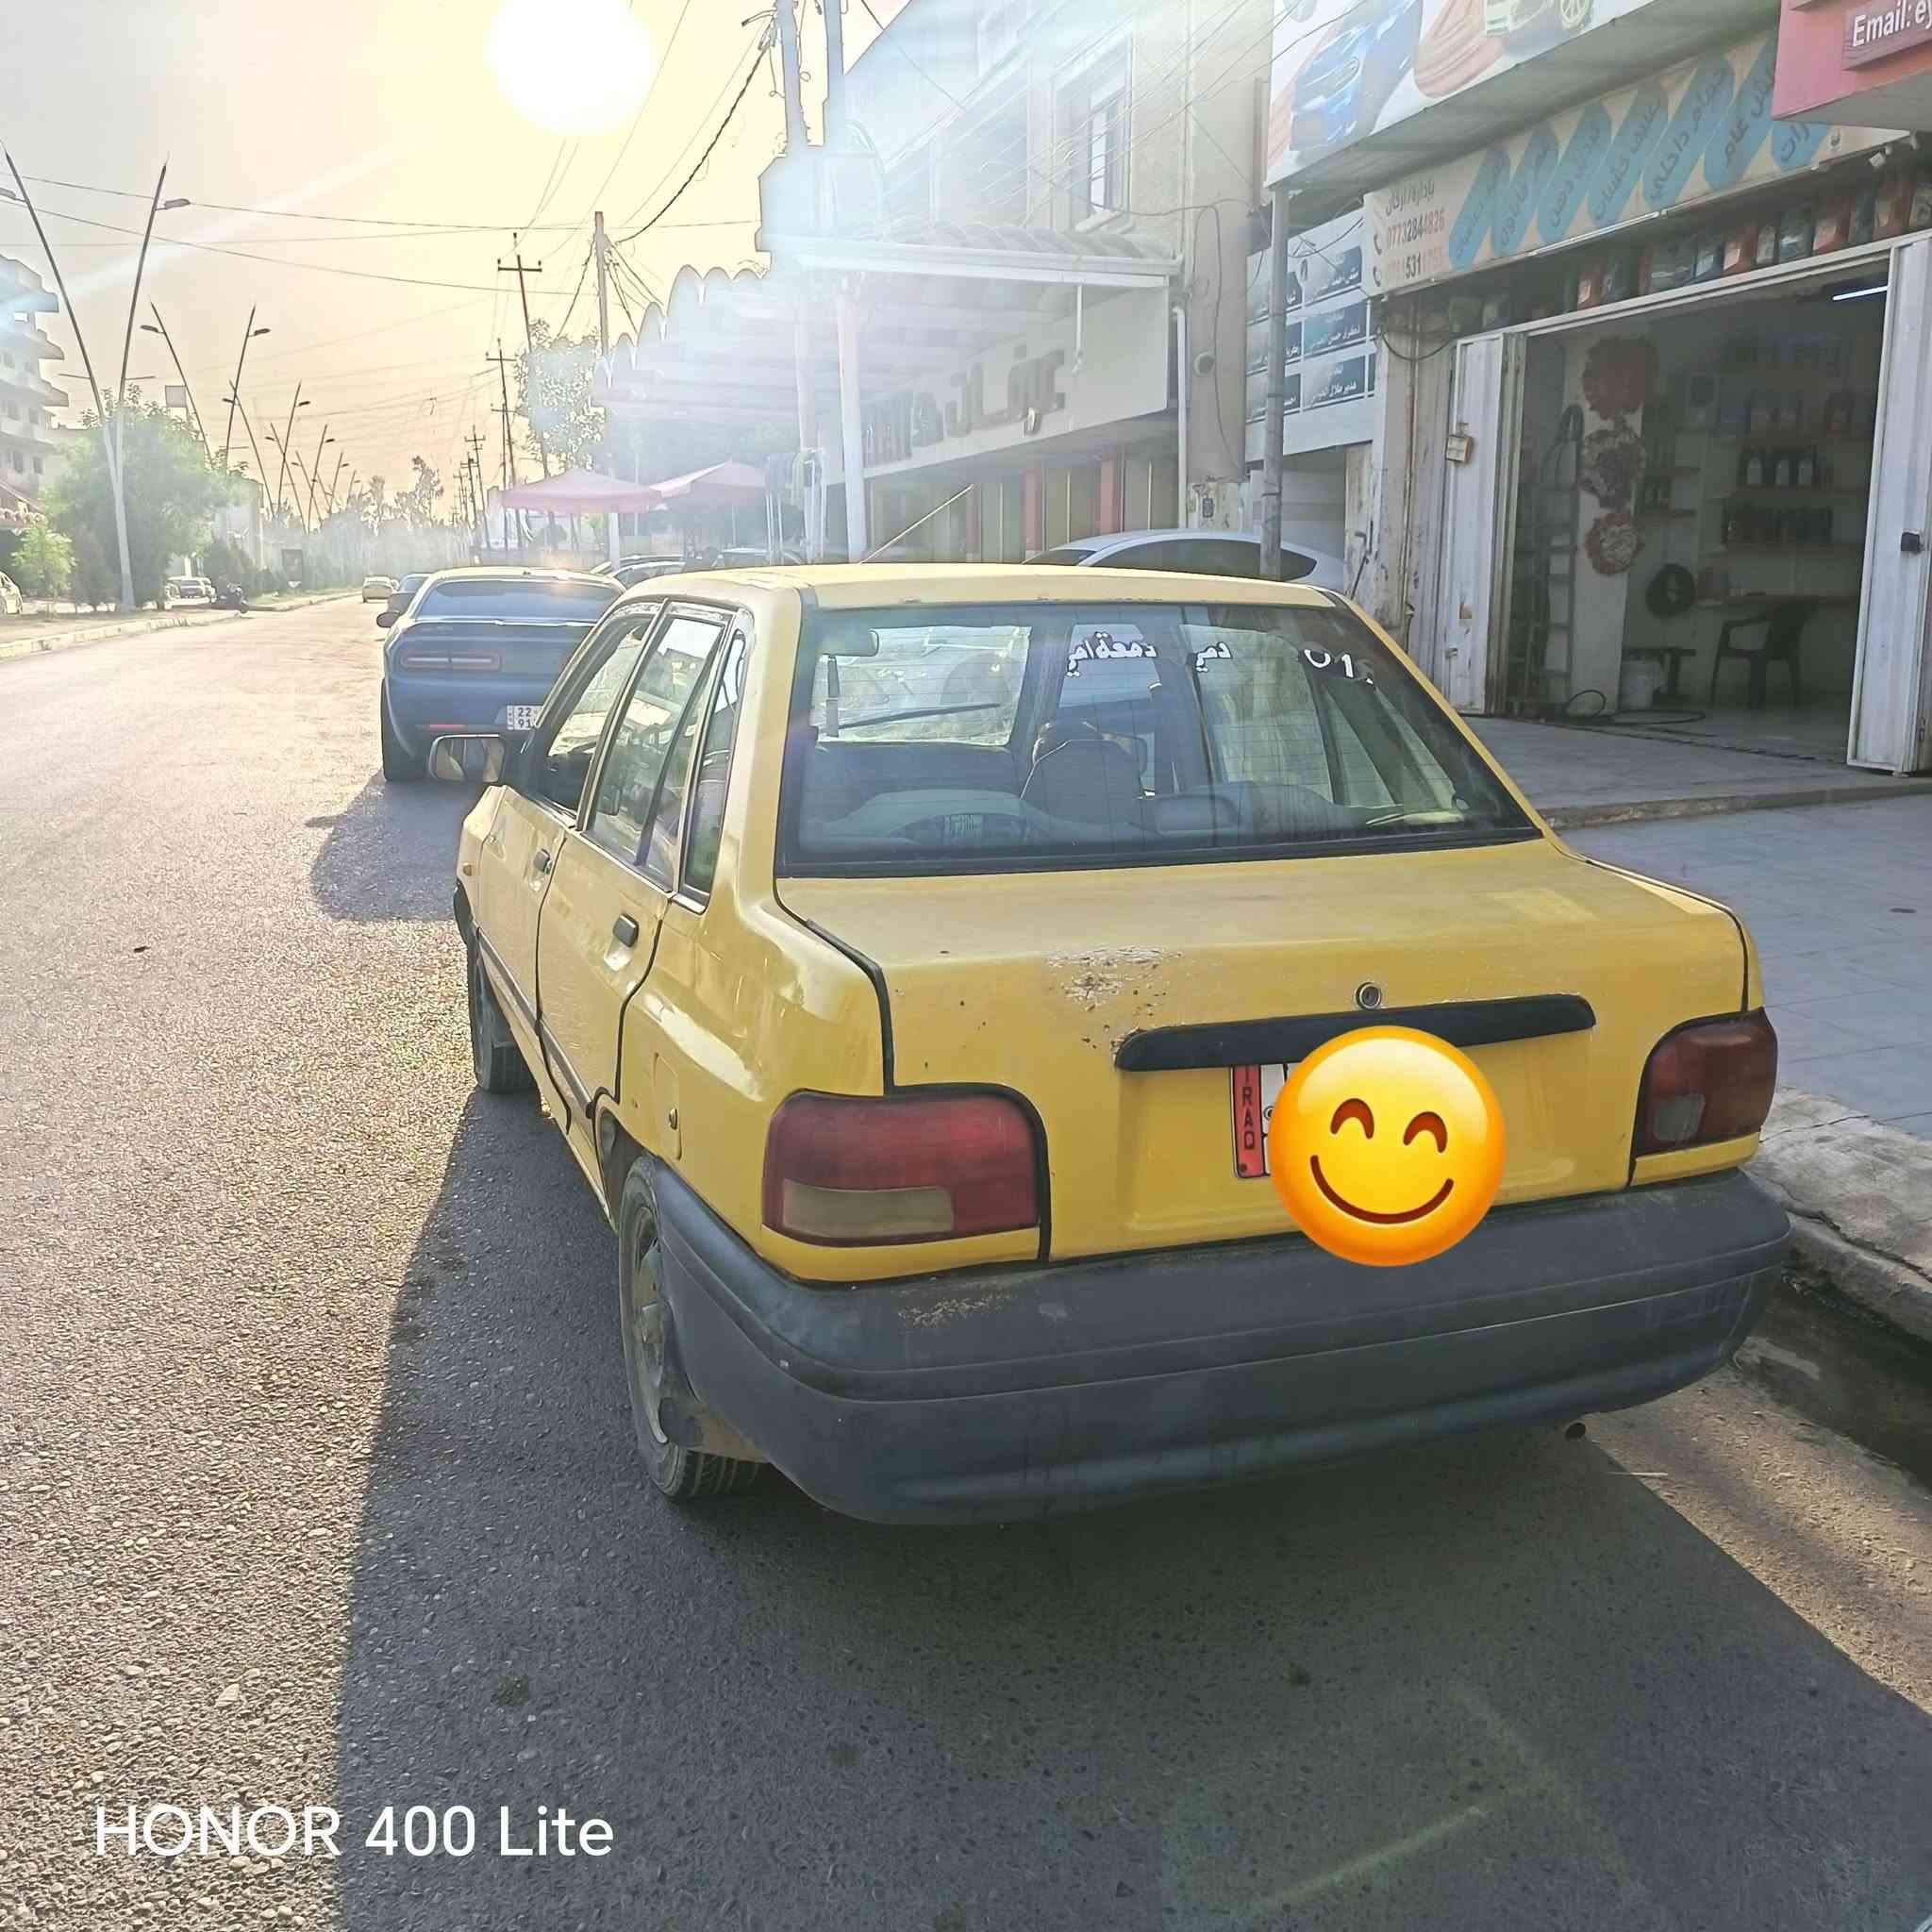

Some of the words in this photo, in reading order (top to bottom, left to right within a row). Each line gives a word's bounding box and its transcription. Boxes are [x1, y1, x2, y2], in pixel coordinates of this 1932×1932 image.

[1852, 0, 1911, 46] Email:
[1064, 638, 1094, 677] امي
[1094, 631, 1158, 658] دمعة
[1241, 1065, 1256, 1150] IRAQ
